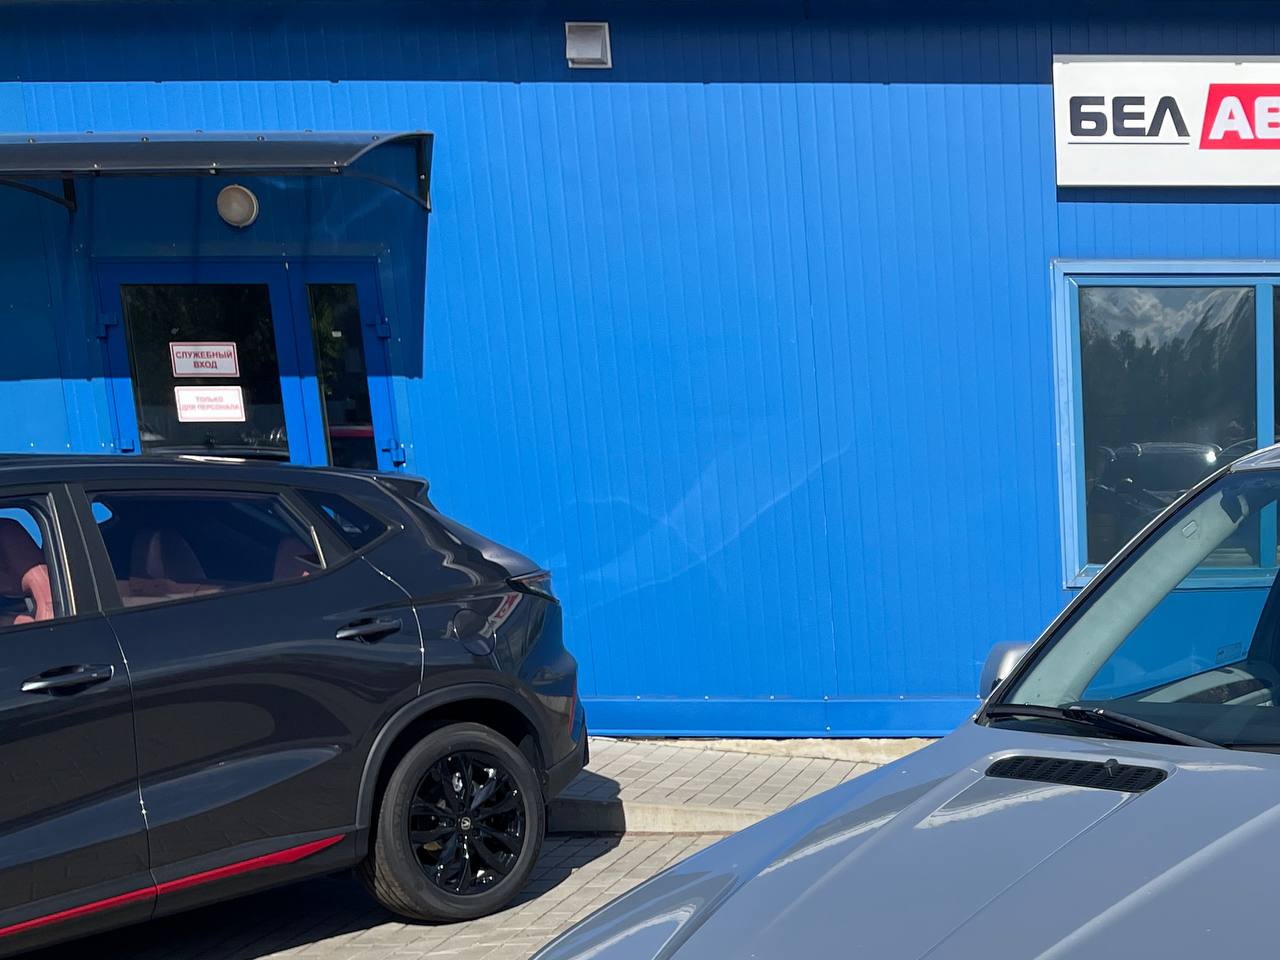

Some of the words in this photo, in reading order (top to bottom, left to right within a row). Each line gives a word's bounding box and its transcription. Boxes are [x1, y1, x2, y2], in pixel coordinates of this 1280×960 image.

[1069, 95, 1190, 138] БЕЛ
[175, 351, 233, 359] СЛУЖЕБНЫЙ
[193, 361, 218, 369] ВХОД
